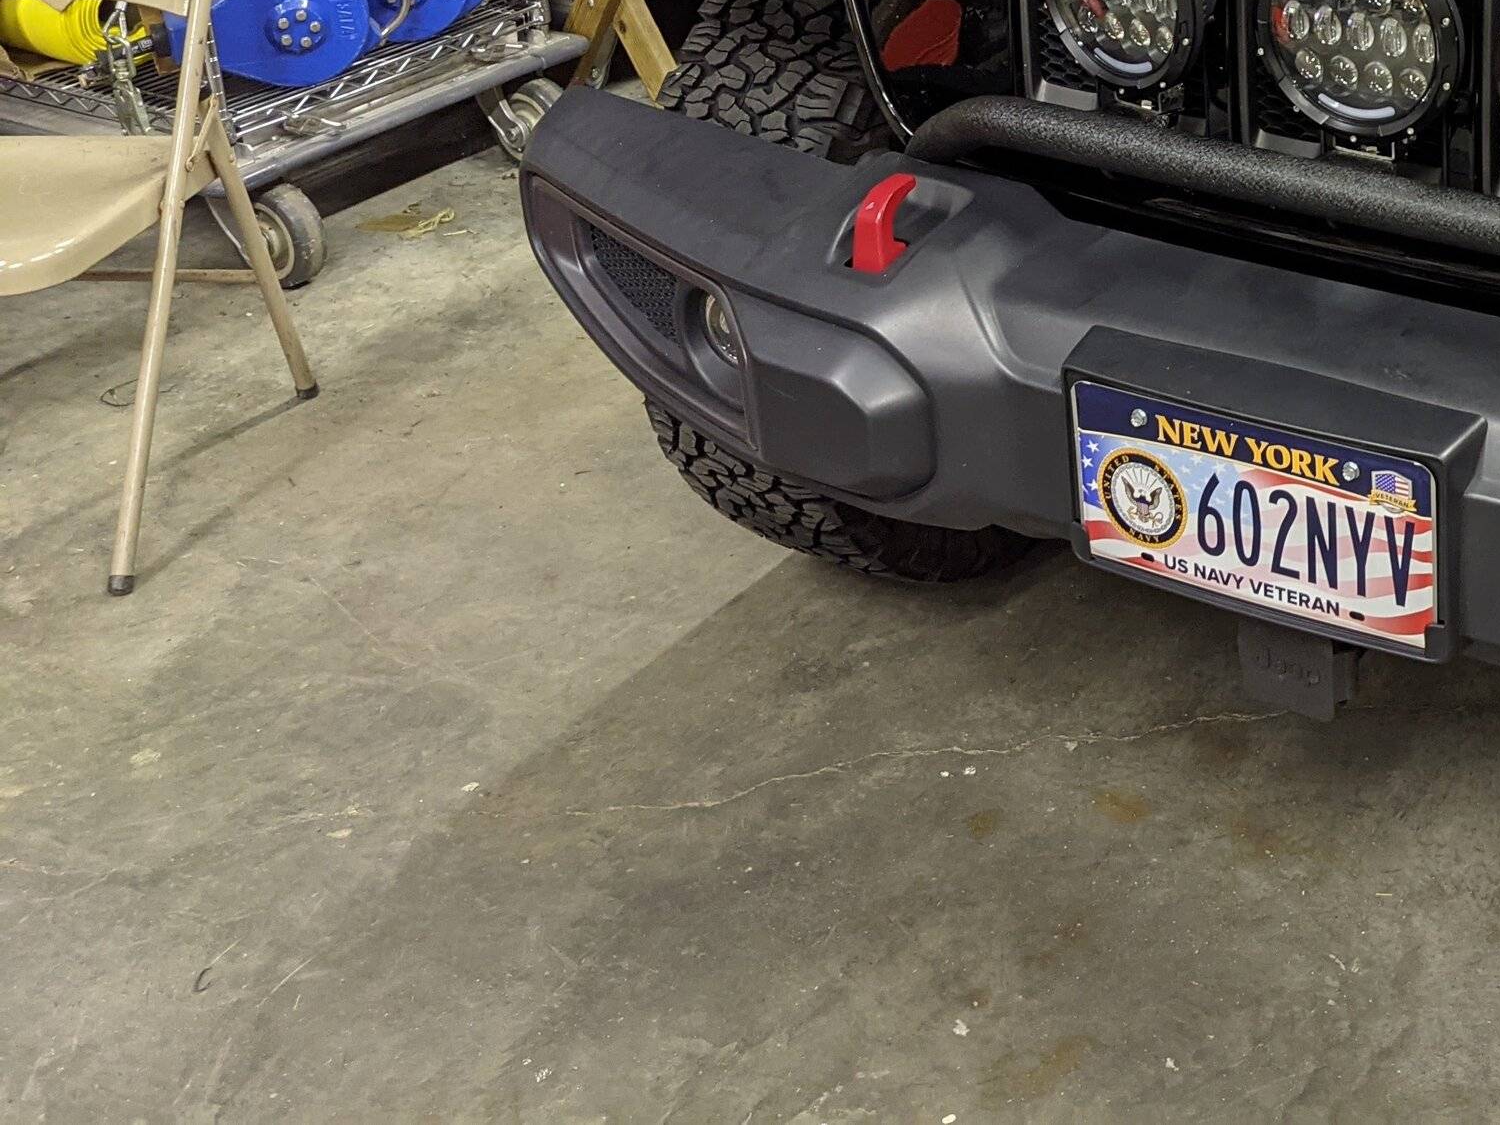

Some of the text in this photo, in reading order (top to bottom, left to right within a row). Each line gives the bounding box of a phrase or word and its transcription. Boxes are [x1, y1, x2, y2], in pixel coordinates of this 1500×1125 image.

[1103, 455, 1130, 500] UNITED
[1155, 415, 1340, 486] NEW YORK
[1129, 528, 1160, 543] NAVY
[1197, 473, 1415, 607] 602NYV
[1164, 554, 1340, 617] US NAVY VETERAN
